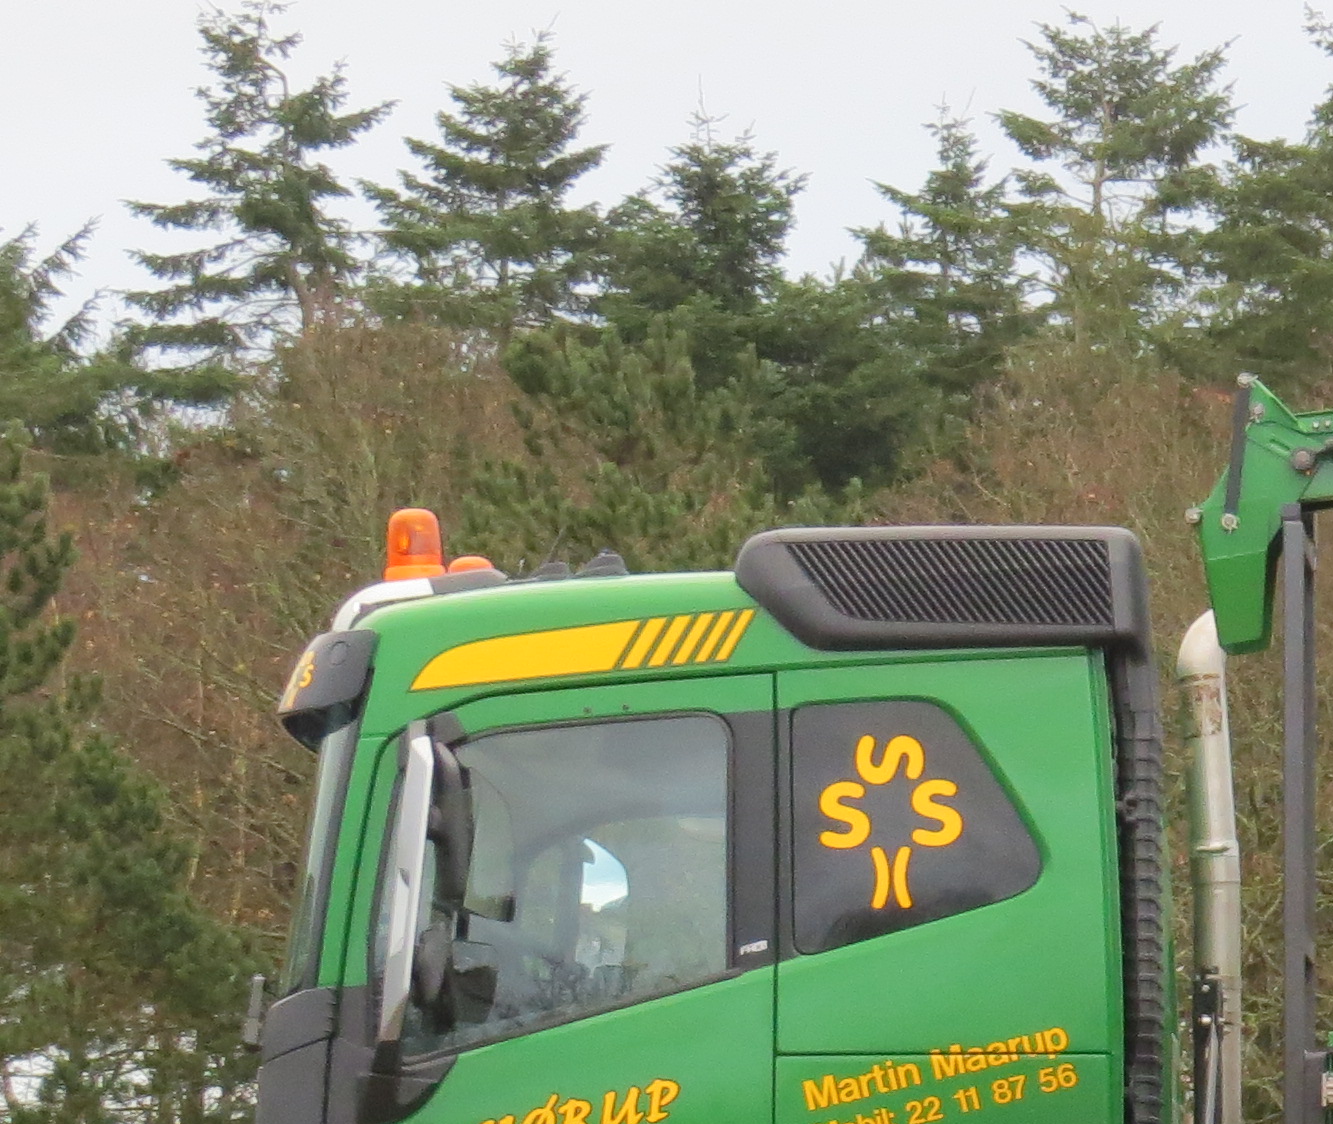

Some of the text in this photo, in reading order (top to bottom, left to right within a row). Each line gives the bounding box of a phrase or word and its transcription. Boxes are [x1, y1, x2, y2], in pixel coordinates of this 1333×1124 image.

[802, 1026, 1070, 1111] Martin Maarup
[953, 1086, 982, 1113] 11
[991, 1074, 1027, 1105] 87
[1039, 1063, 1079, 1093] 56
